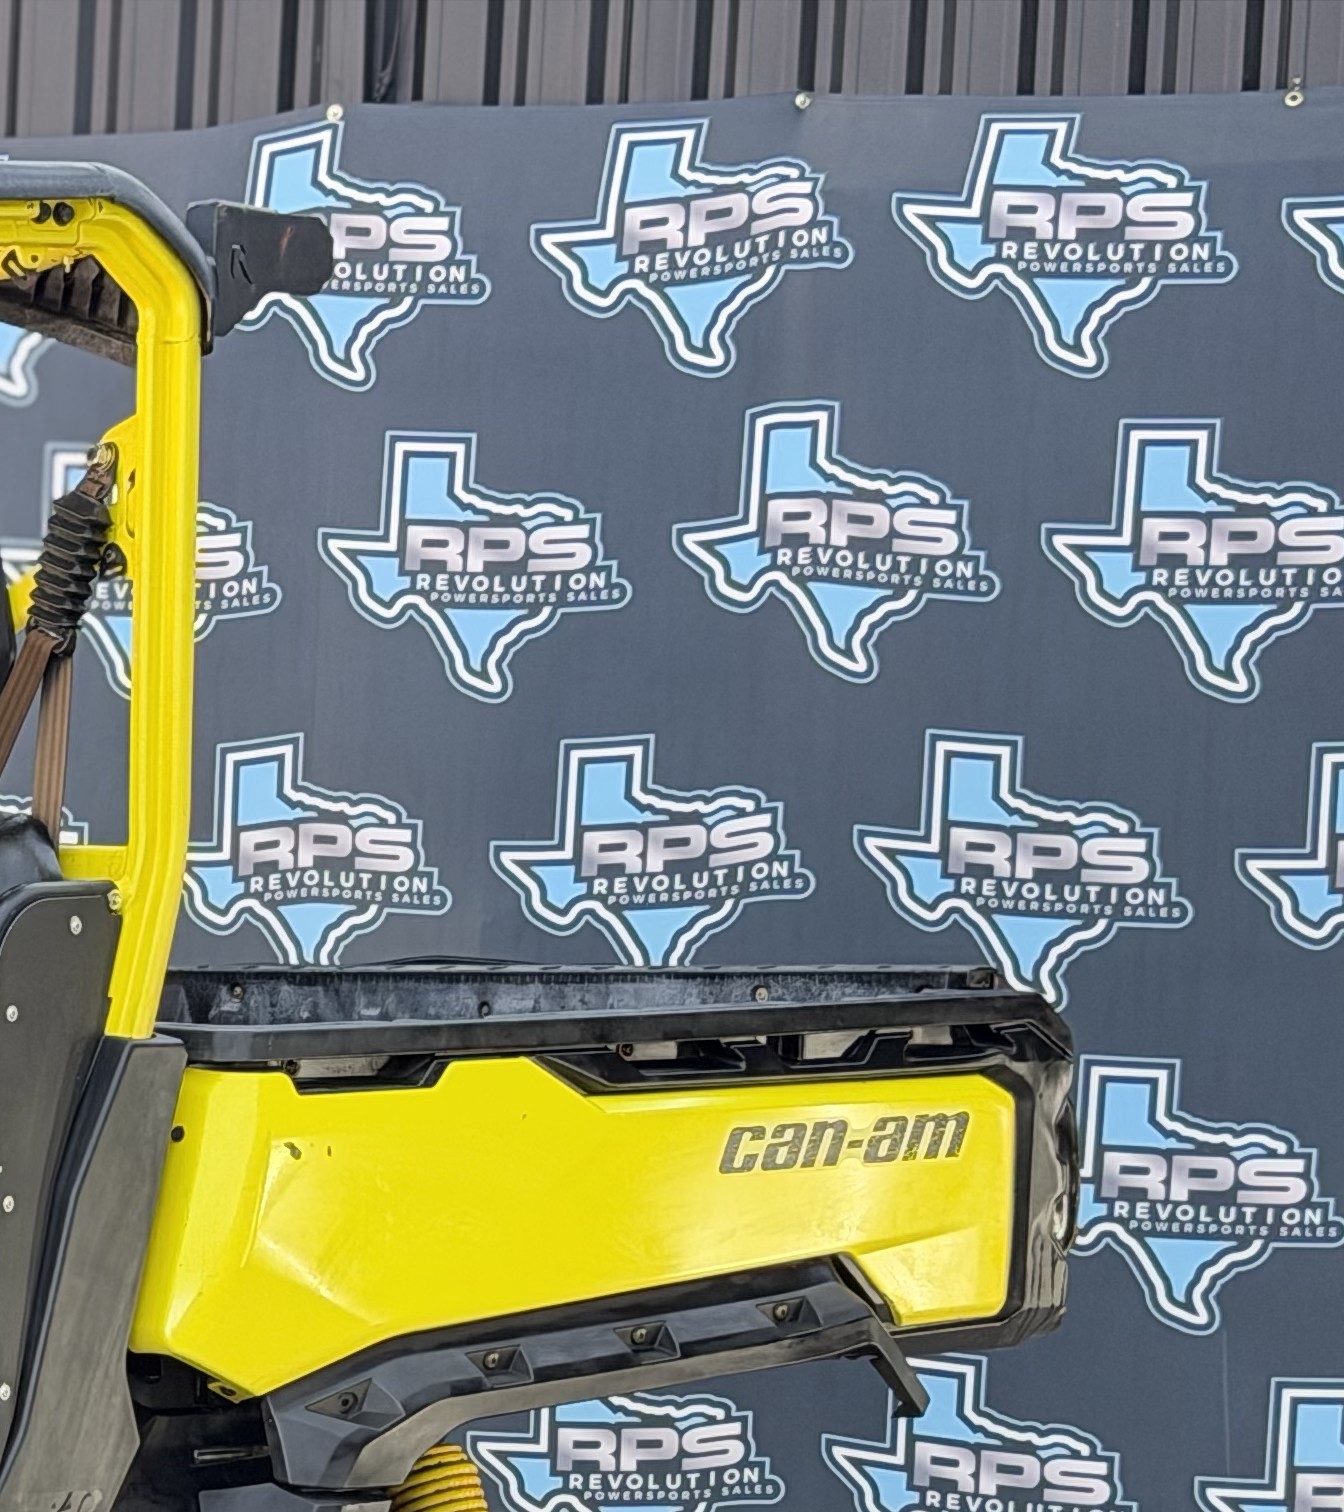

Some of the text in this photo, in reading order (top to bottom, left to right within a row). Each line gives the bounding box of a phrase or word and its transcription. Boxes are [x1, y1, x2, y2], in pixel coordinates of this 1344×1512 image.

[623, 181, 813, 255] RPS
[989, 191, 1195, 240] RPS
[330, 213, 452, 262] PS
[634, 227, 828, 273] REVOLUTION
[1002, 241, 1211, 261] REVOLUTION
[334, 262, 465, 282] OLUTION
[649, 248, 841, 283] POWERSPORTS SALES
[1017, 262, 1225, 273] POWERSPORTS SALES
[332, 280, 480, 294] ERSPORTS SALES
[765, 498, 959, 555] RPS
[405, 525, 592, 572] RPS
[1139, 517, 1344, 566] RPS
[777, 547, 973, 578] REVOLUTION
[416, 572, 606, 592] REVOLUTION
[792, 566, 989, 591] POWERSPORTS SALES
[1152, 567, 1342, 586] REVOLUTIO
[221, 594, 271, 609] SALES
[431, 589, 620, 603] POWERSPORTS SALES
[1168, 587, 1309, 598] POWERSPORTS
[238, 823, 414, 876] RPS
[581, 813, 774, 877] RPS
[948, 827, 1149, 884] RPS
[250, 870, 428, 894] REVOLUTION
[593, 861, 789, 895] REVOLUTION
[608, 878, 804, 905] POWERSPORTS SALES
[960, 877, 1165, 904] REVOLUTION
[264, 887, 441, 905] POWERSPORTS SALES
[976, 898, 1181, 918] POWERSPORTS SALES
[718, 1111, 970, 1174] can-am
[1100, 1151, 1307, 1204] RPS
[1114, 1201, 1322, 1225] REVOLUTION
[1129, 1220, 1337, 1237] POWERSPORTS SALES
[556, 1422, 745, 1471] RPS
[569, 1467, 759, 1490] REVOLUTION
[913, 1441, 1110, 1505] RPS
[584, 1485, 773, 1500] POWERSPORTS SALES
